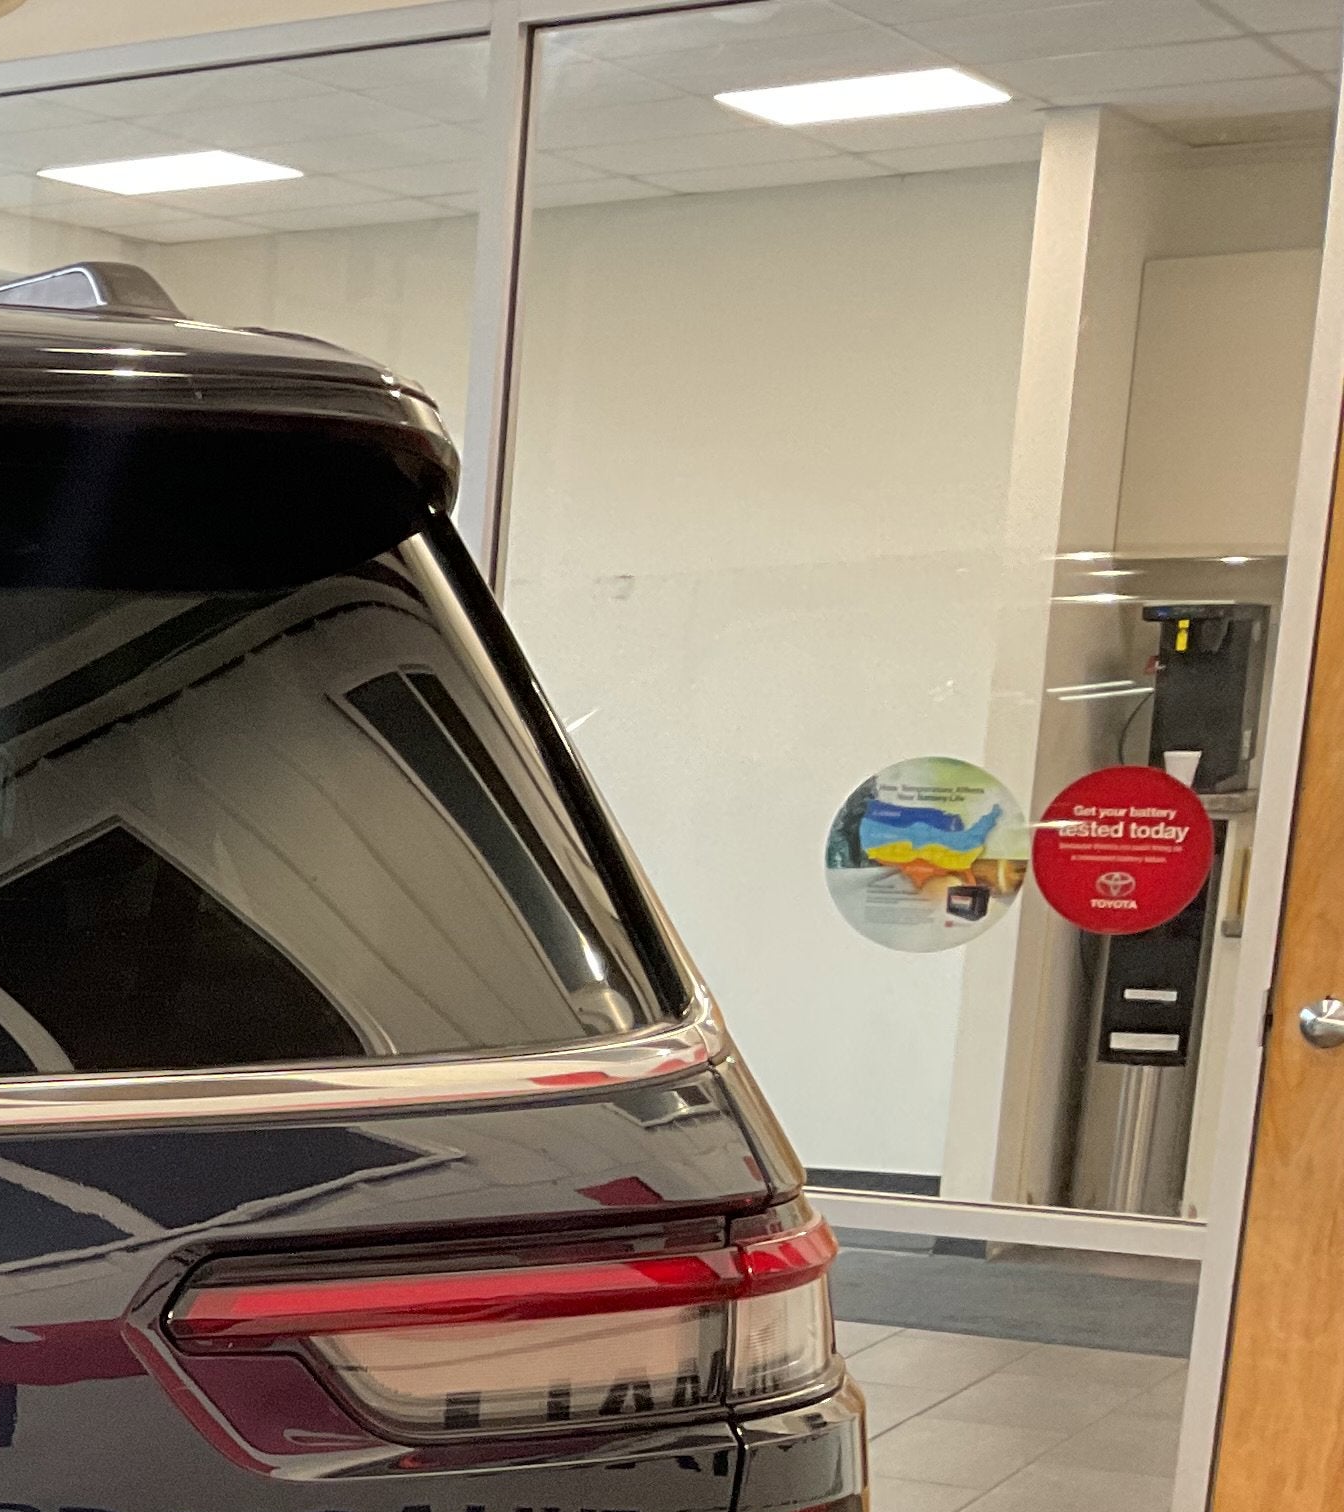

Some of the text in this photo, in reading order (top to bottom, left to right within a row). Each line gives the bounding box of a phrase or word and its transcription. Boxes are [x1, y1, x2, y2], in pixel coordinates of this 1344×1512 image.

[1073, 805, 1177, 820] Get your battery
[1129, 822, 1190, 843] today
[1090, 899, 1138, 910] TOYOTA
